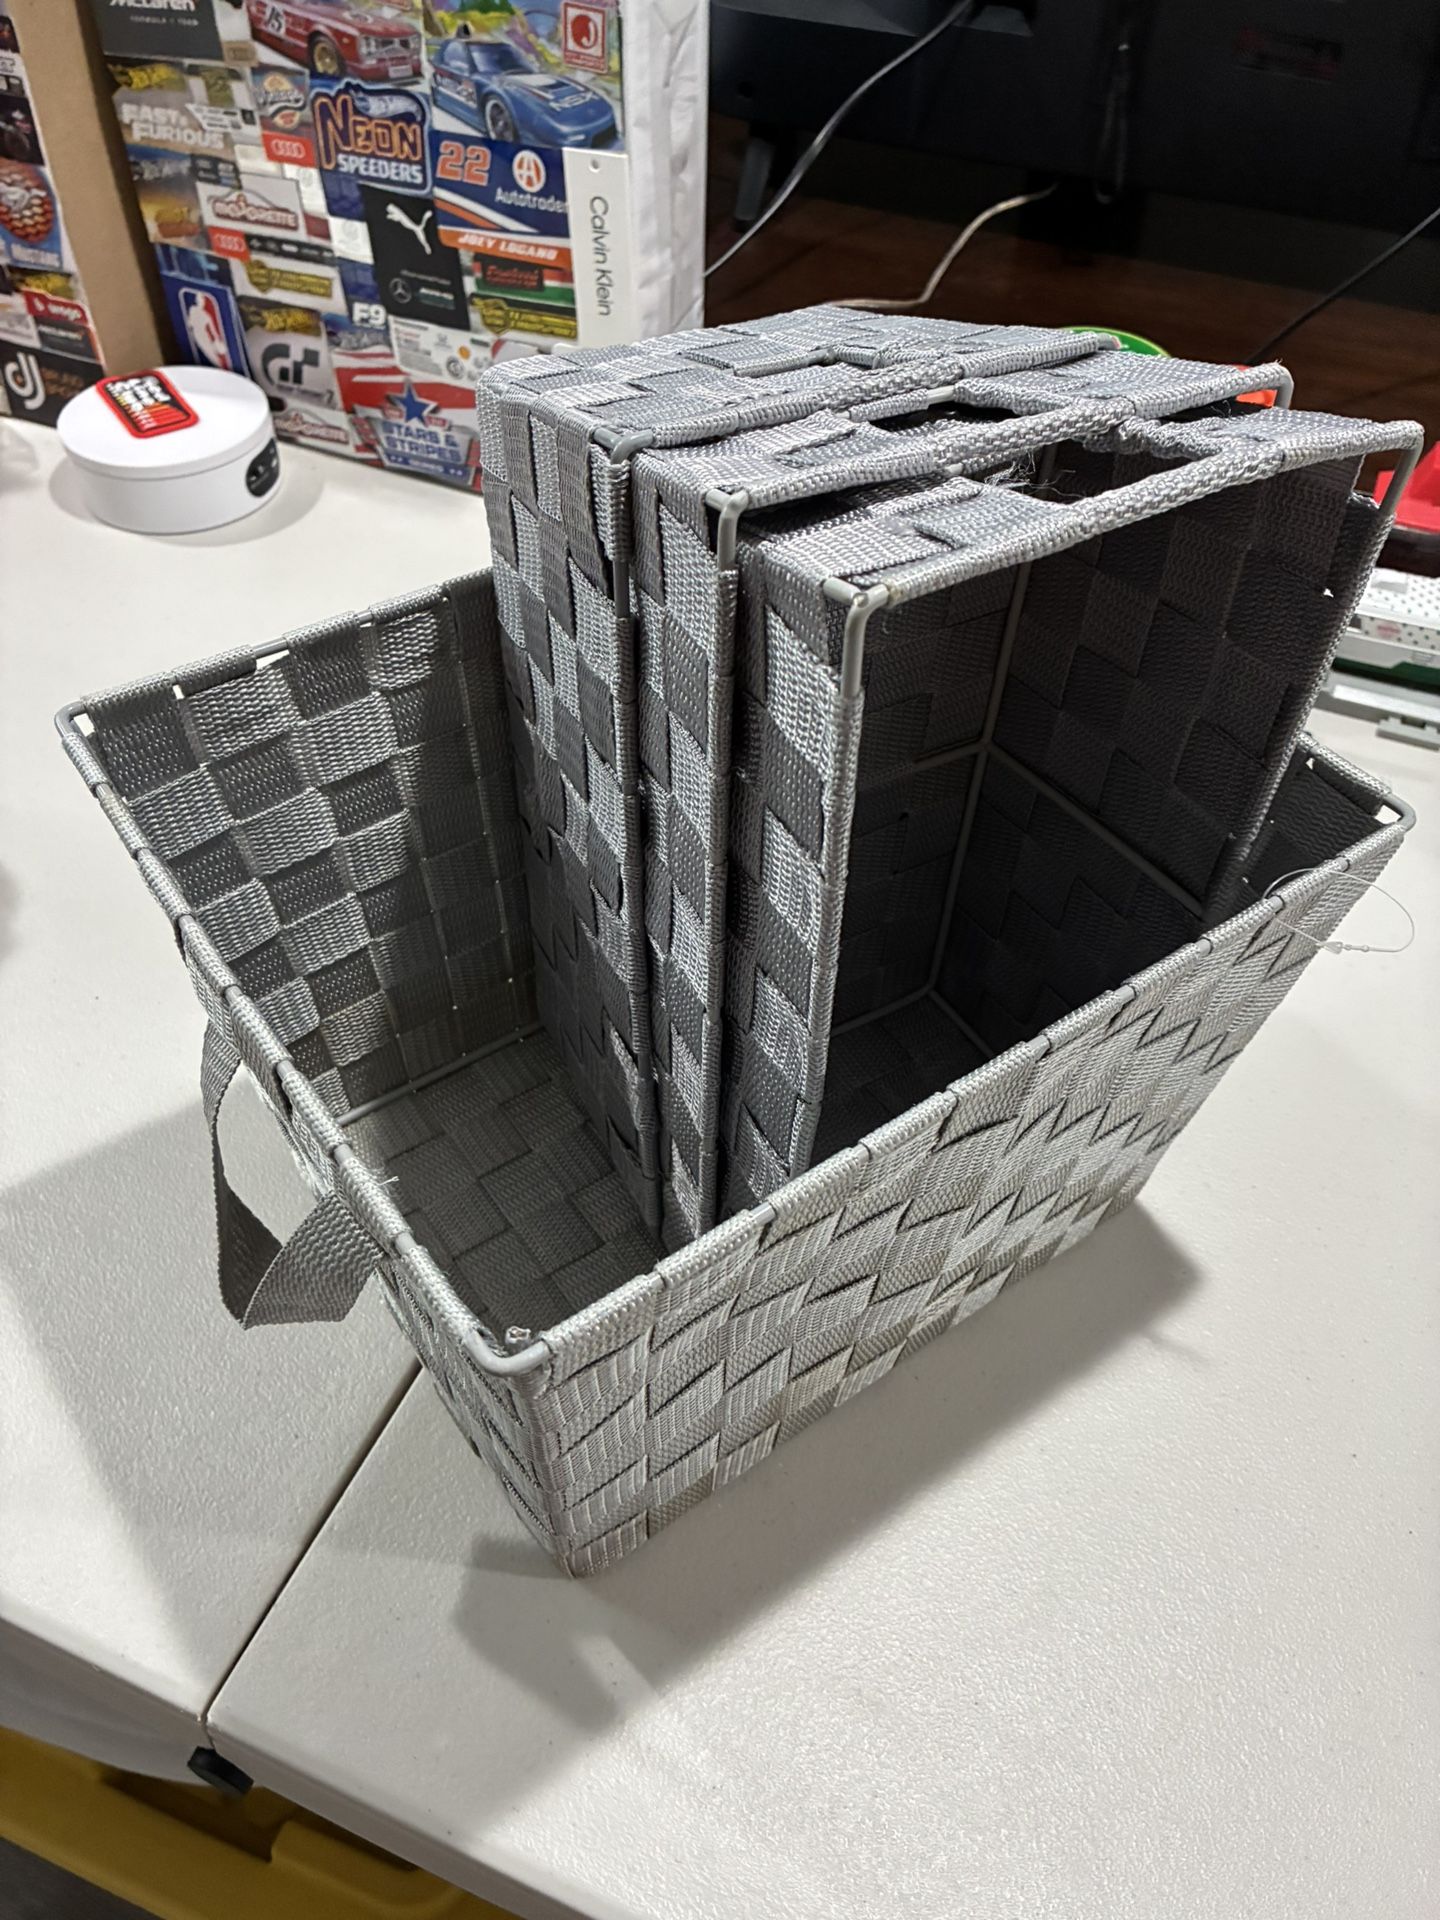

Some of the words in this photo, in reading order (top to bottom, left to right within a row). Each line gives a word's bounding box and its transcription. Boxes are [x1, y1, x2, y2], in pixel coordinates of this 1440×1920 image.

[265, 5, 284, 33] 15
[121, 102, 180, 125] FAST
[131, 120, 225, 150] FURIOUS
[337, 153, 424, 184] SPEEDERS
[435, 140, 492, 187] 22
[588, 195, 612, 268] Calvin
[457, 233, 497, 249] JOEY
[499, 240, 559, 261] LOGANO
[593, 268, 615, 317] Klein
[352, 301, 387, 327] F9
[381, 421, 441, 445] STARS
[384, 435, 464, 464] STRIPES
